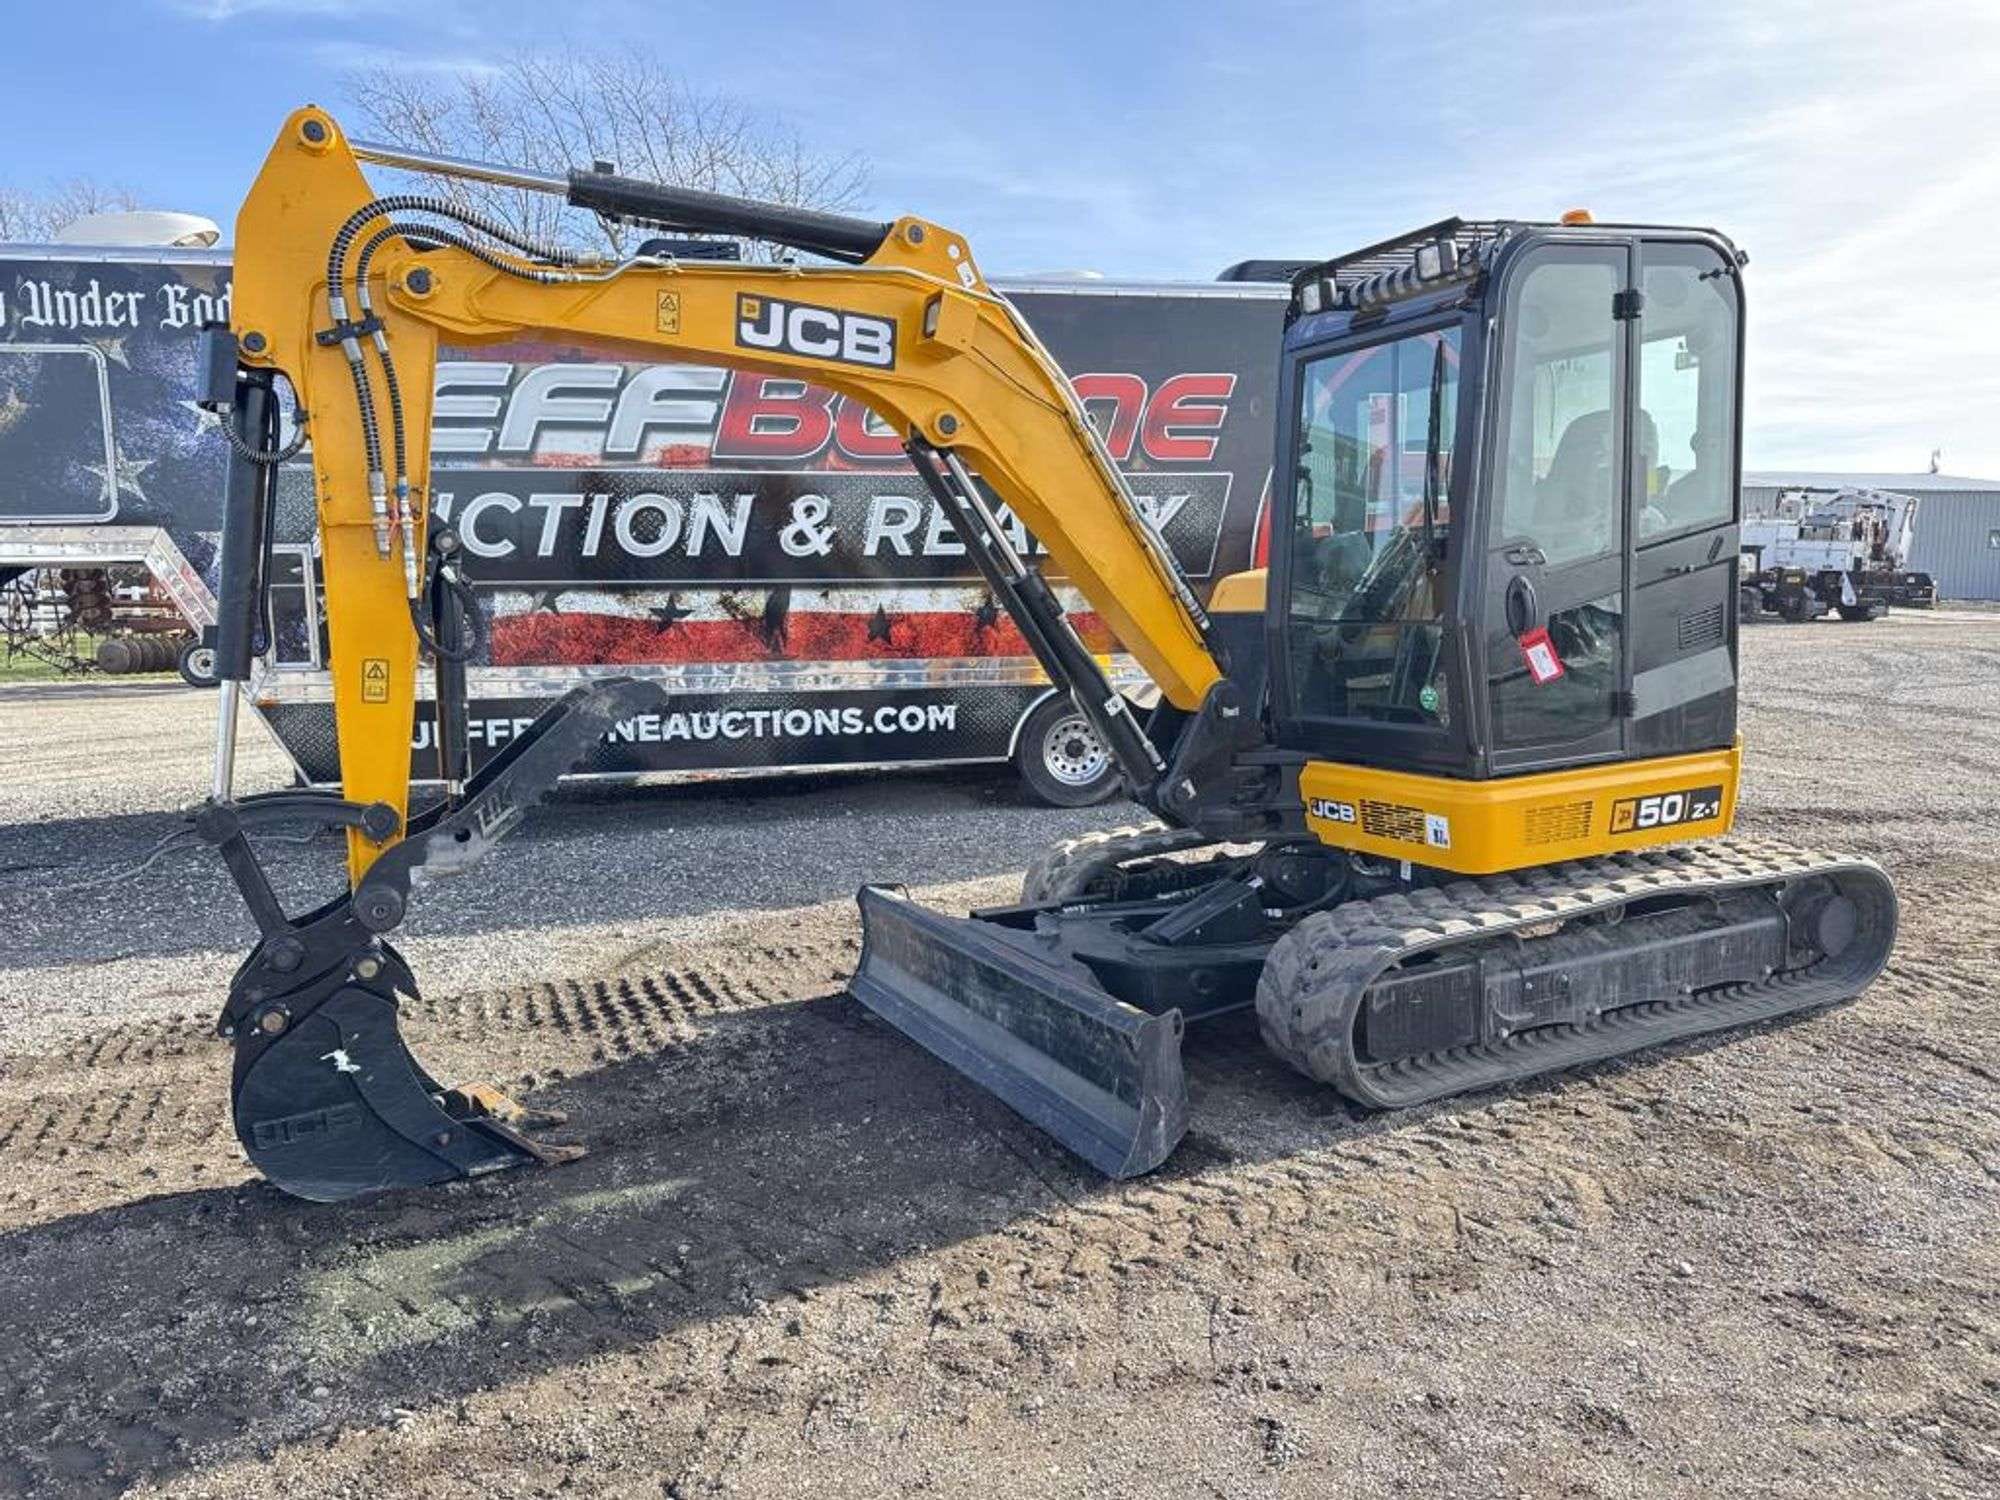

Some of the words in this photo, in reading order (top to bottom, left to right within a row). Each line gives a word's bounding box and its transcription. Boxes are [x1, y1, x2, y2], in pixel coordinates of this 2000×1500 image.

[18, 278, 146, 329] Under
[740, 302, 893, 365] JCB
[779, 494, 838, 557] &
[1311, 801, 1356, 822] JCB
[1637, 794, 1683, 827] 50
